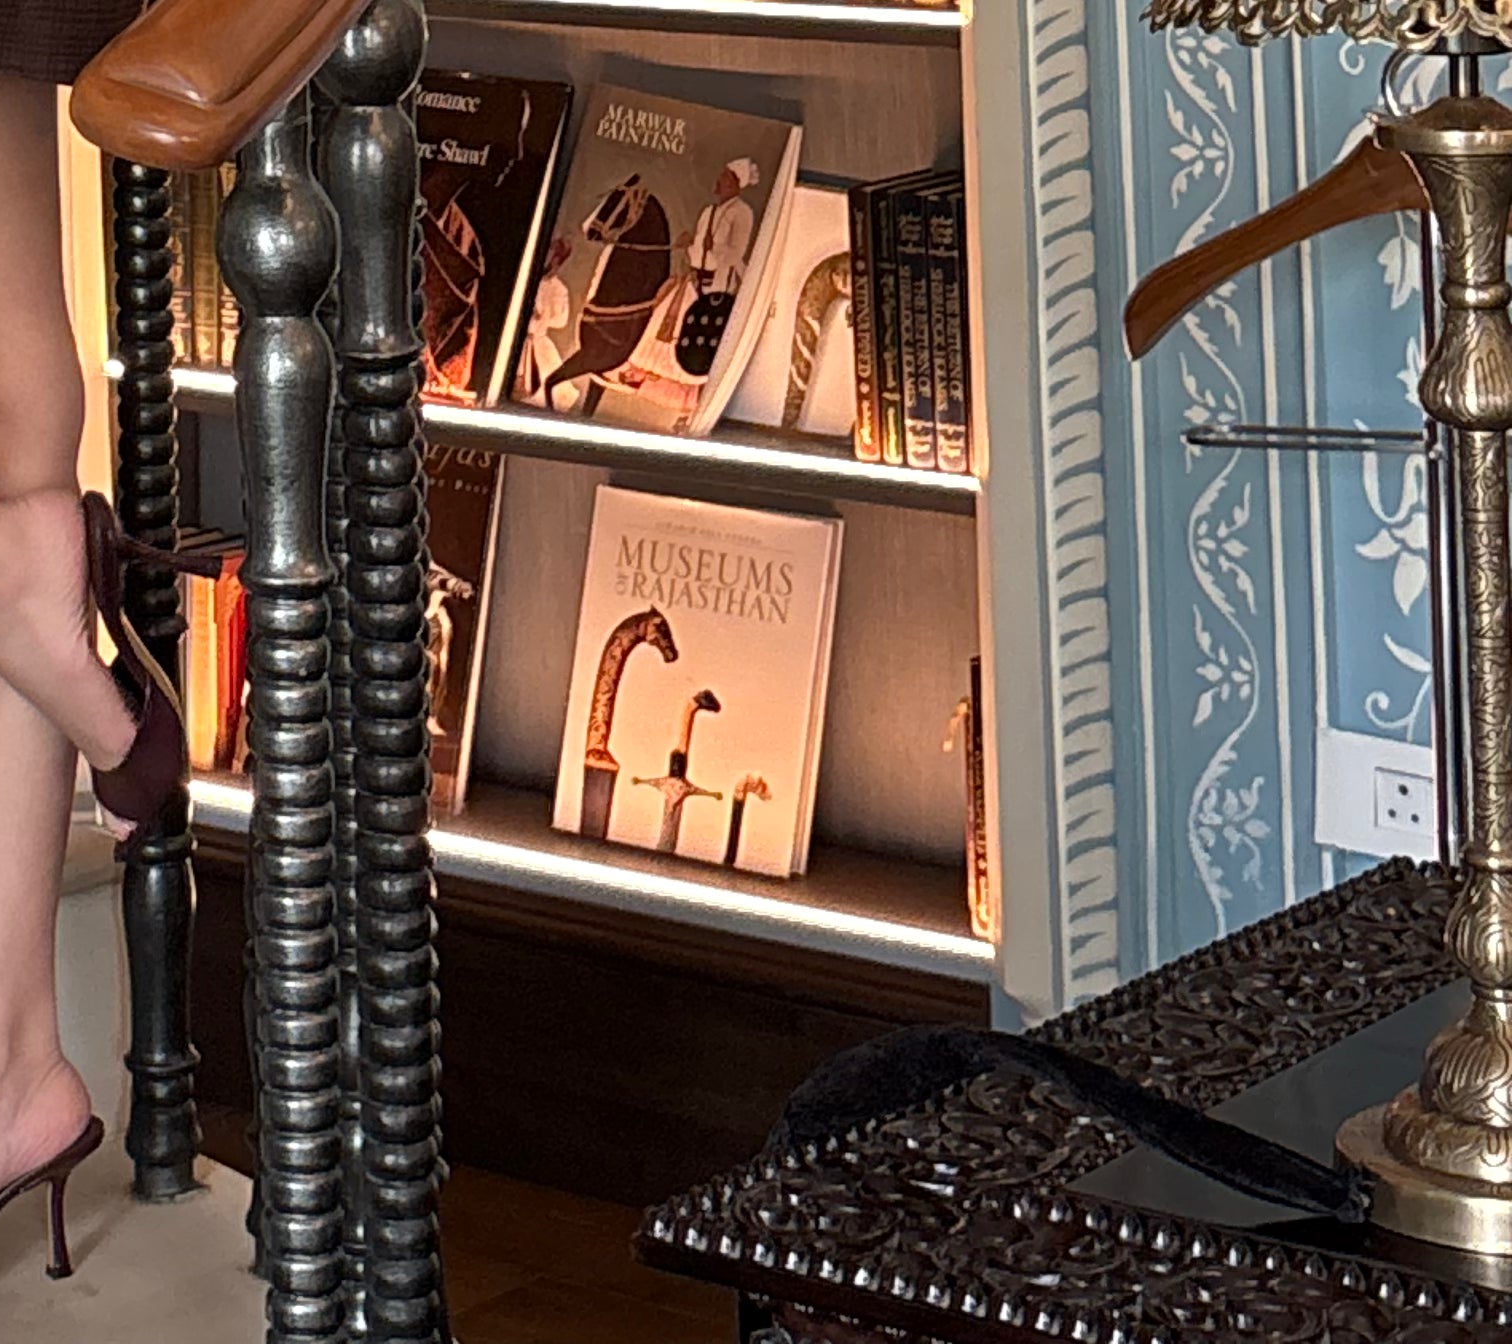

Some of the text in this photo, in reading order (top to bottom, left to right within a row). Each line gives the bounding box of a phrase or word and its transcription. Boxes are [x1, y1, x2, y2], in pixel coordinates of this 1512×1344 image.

[416, 85, 482, 114] omance
[606, 103, 686, 137] MARWAR
[595, 114, 686, 155] PAINTING
[616, 535, 794, 596] MUSEUMS
[631, 571, 791, 625] RAJASTHAN
